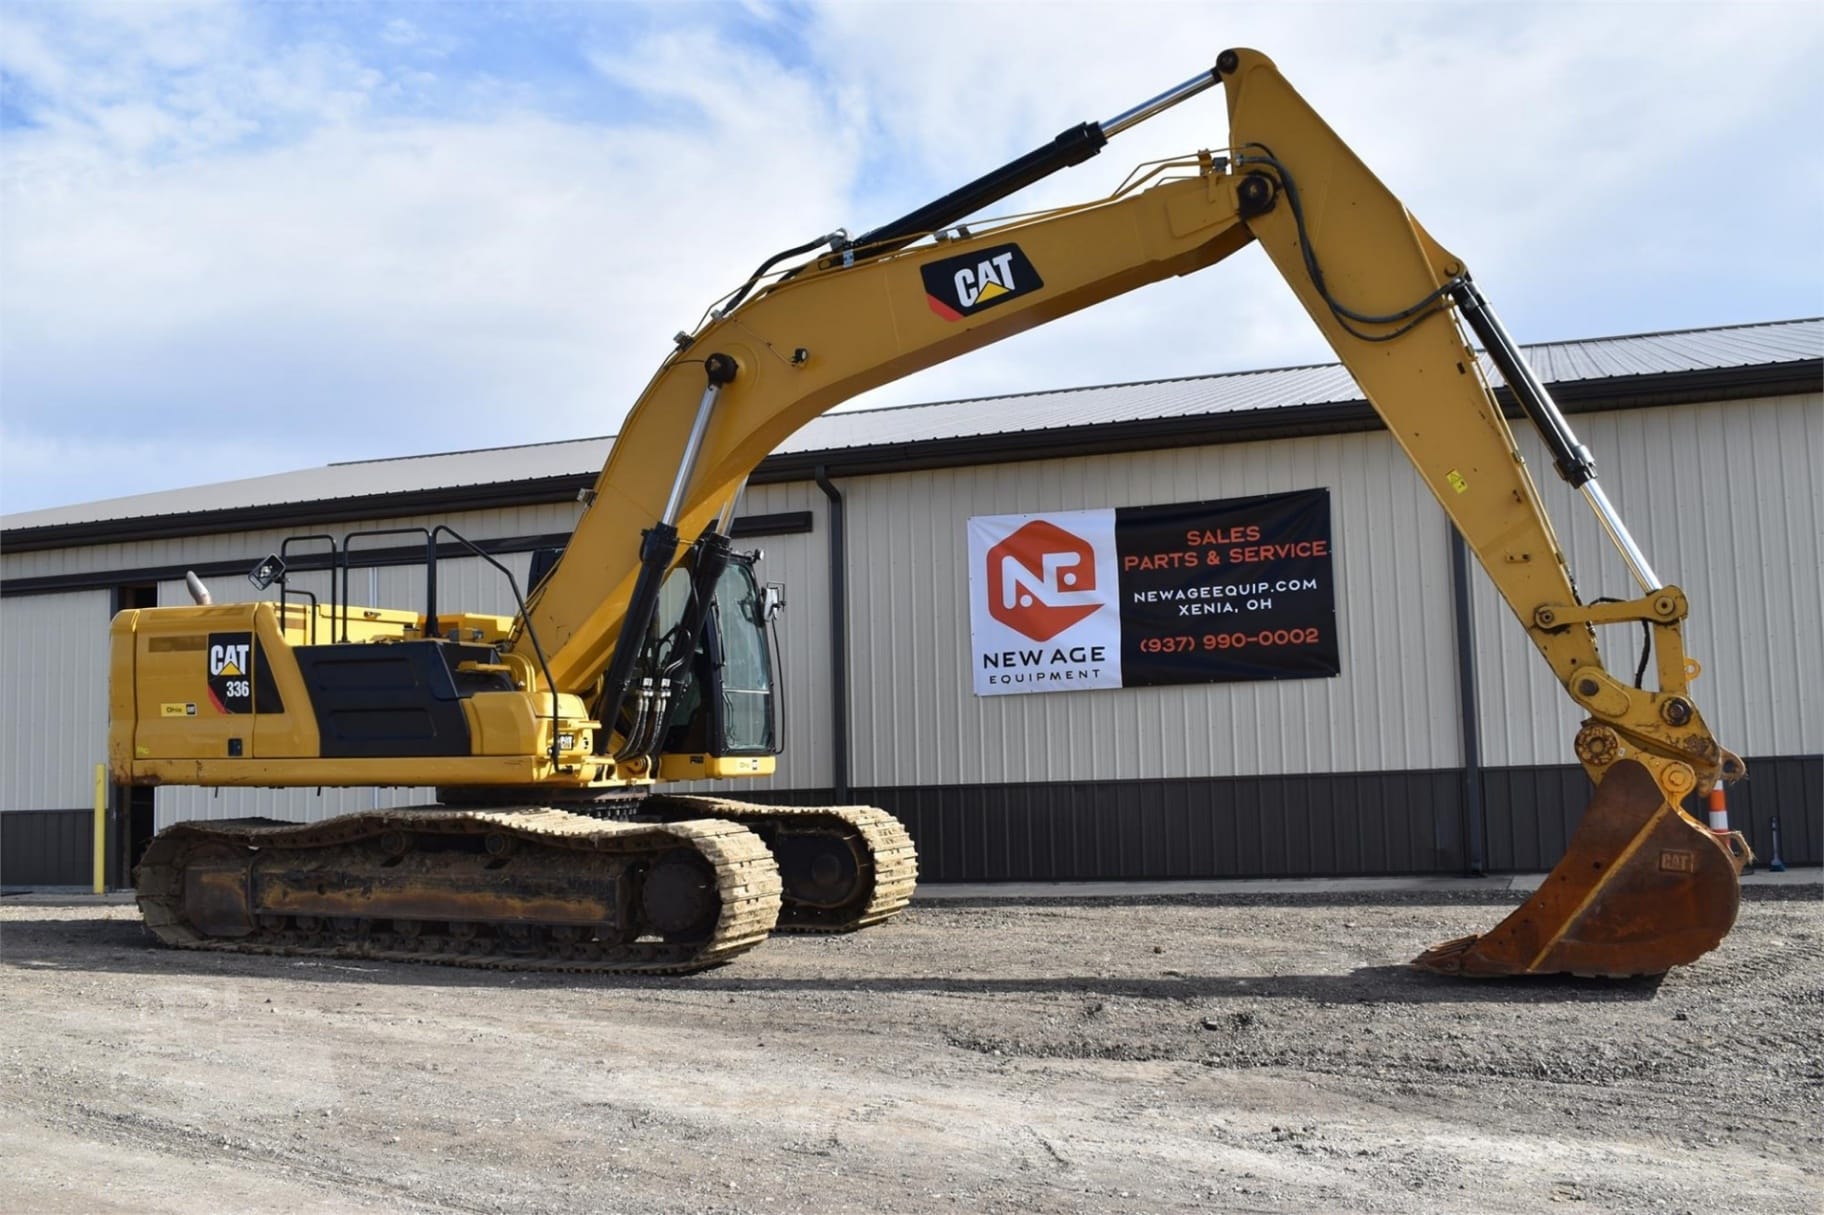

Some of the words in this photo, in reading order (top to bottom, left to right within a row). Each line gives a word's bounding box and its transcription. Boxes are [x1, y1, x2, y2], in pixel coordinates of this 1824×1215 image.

[954, 252, 1015, 307] CAT
[1186, 526, 1261, 546] SALES
[1124, 552, 1198, 571] PARTS
[1206, 550, 1220, 565] &
[1229, 540, 1327, 563] SERVICE
[1134, 578, 1317, 603] NEWAGEEQUIP.COM
[1178, 602, 1239, 616] XENIA,
[1246, 598, 1272, 611] OH
[1140, 636, 1196, 652] (937)
[1203, 628, 1319, 650] 990-0002
[211, 644, 249, 676] CAT
[983, 649, 1043, 669] NEW
[1050, 646, 1105, 664] AGE
[226, 680, 250, 697] 336
[989, 669, 1100, 685] EQUIPMENT
[1661, 853, 1689, 870] CAT
